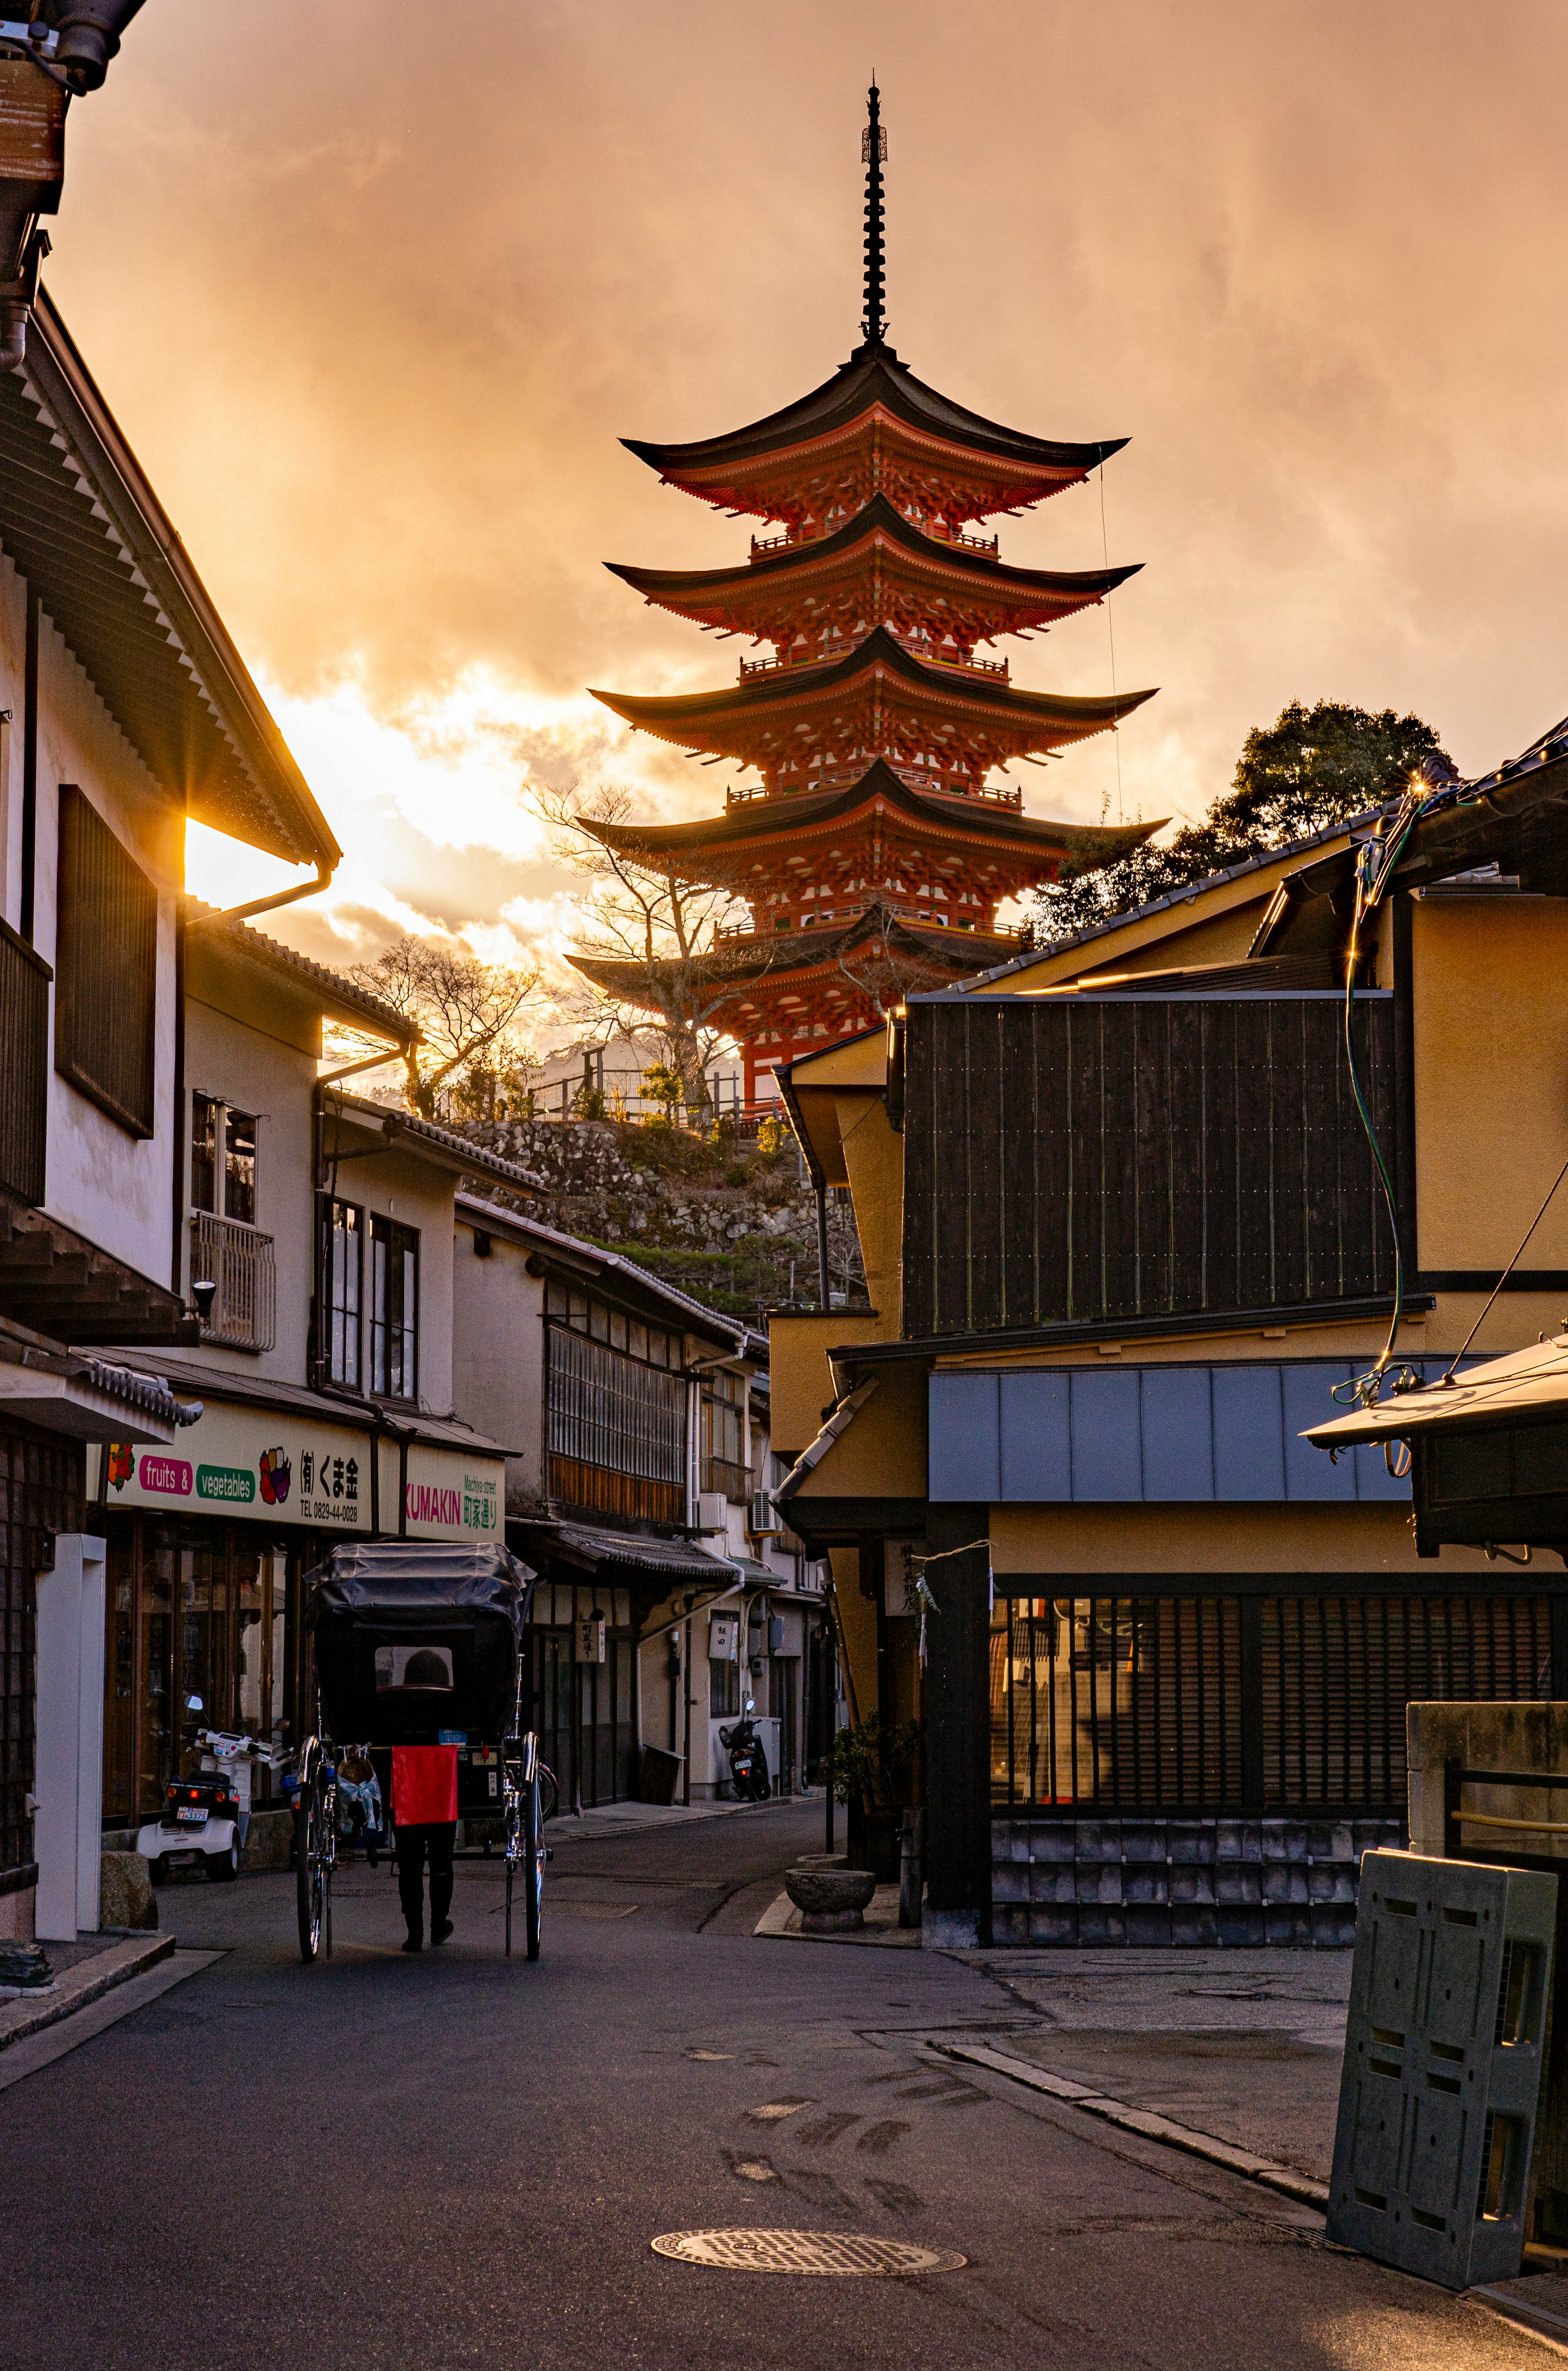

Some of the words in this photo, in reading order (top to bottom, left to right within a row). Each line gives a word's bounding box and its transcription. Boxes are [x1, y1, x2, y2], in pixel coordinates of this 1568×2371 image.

[147, 1460, 175, 1489] fruits
[182, 1469, 188, 1490] &
[202, 1473, 250, 1498] vegetables
[301, 1500, 312, 1517] TEL
[314, 1502, 357, 1523] 0829-44-0028
[464, 1496, 497, 1529] 町家通り
[717, 1626, 727, 1645] 飯田
